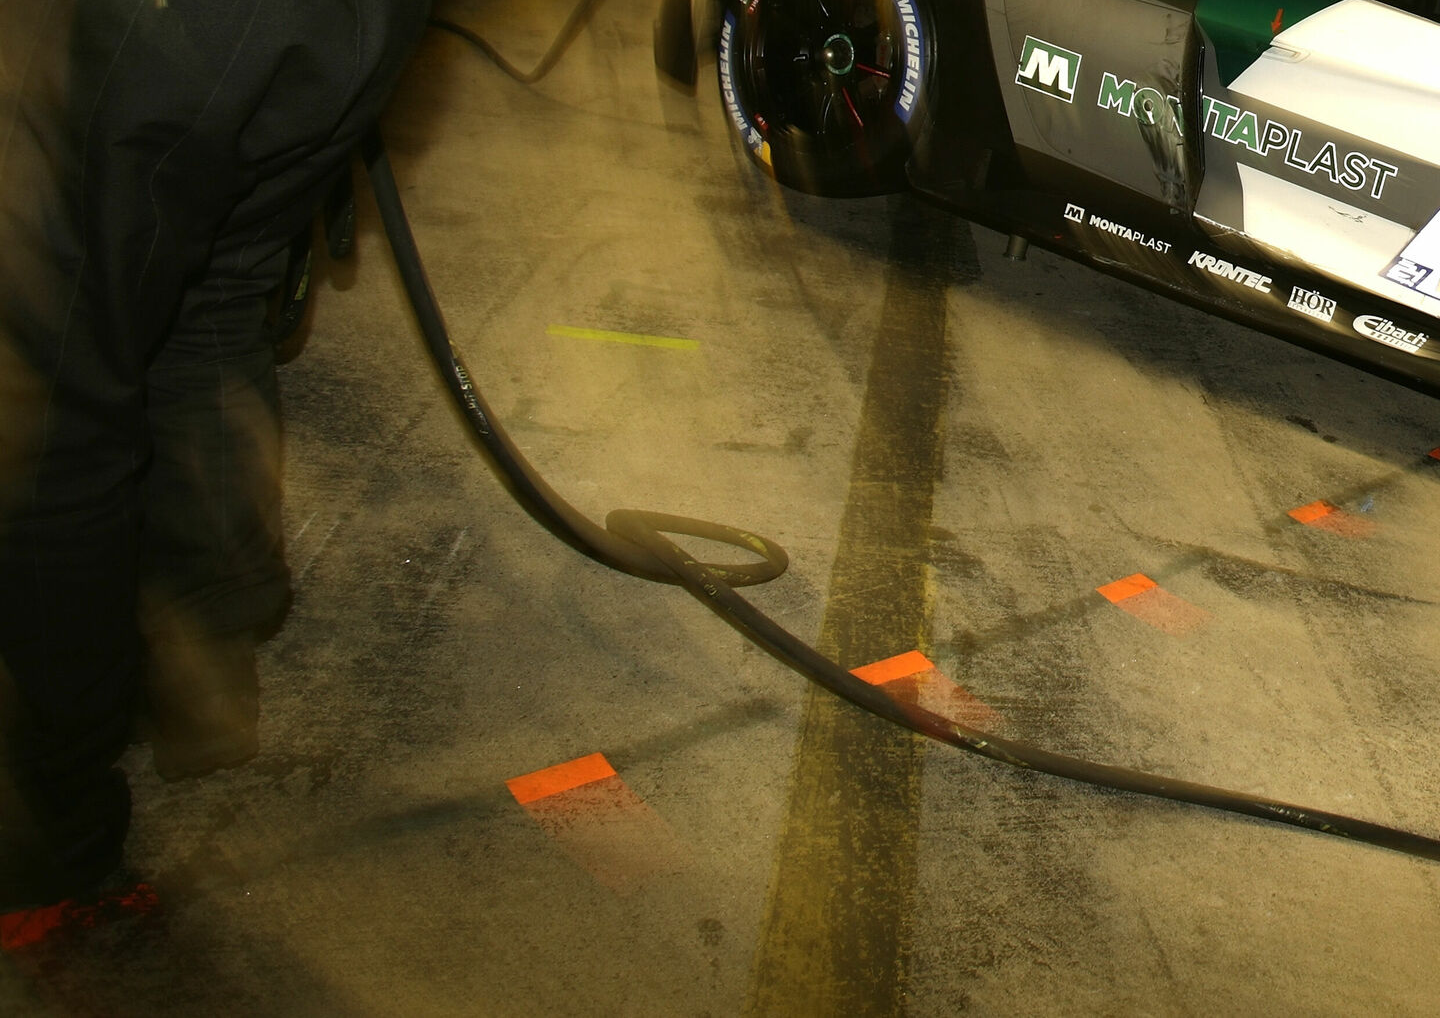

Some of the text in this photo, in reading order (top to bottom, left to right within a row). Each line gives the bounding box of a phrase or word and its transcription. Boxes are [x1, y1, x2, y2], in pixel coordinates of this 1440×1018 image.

[720, 20, 748, 131] MICHELIN
[1089, 214, 1171, 254] MONTAPLAST
[1188, 250, 1272, 294] KRONTEC
[1291, 288, 1334, 317] HÖR
[1353, 314, 1428, 350] Eibach
